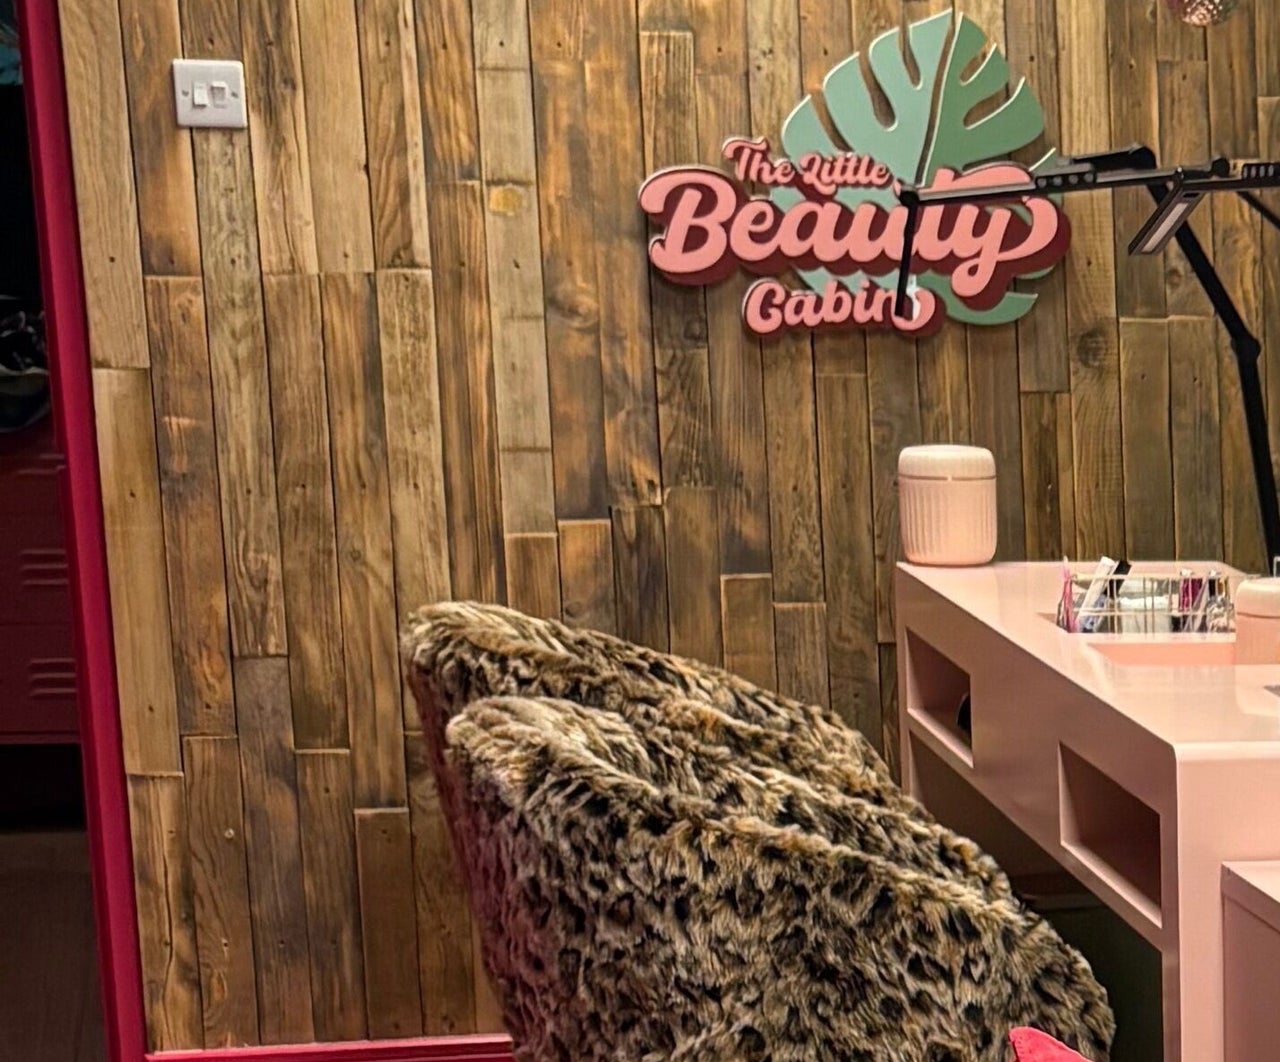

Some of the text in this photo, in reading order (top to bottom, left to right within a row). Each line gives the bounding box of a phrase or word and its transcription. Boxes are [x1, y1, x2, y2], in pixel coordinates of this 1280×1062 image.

[722, 139, 891, 195] The Little
[640, 166, 1059, 297] Beauty
[744, 279, 936, 332] Cabin
